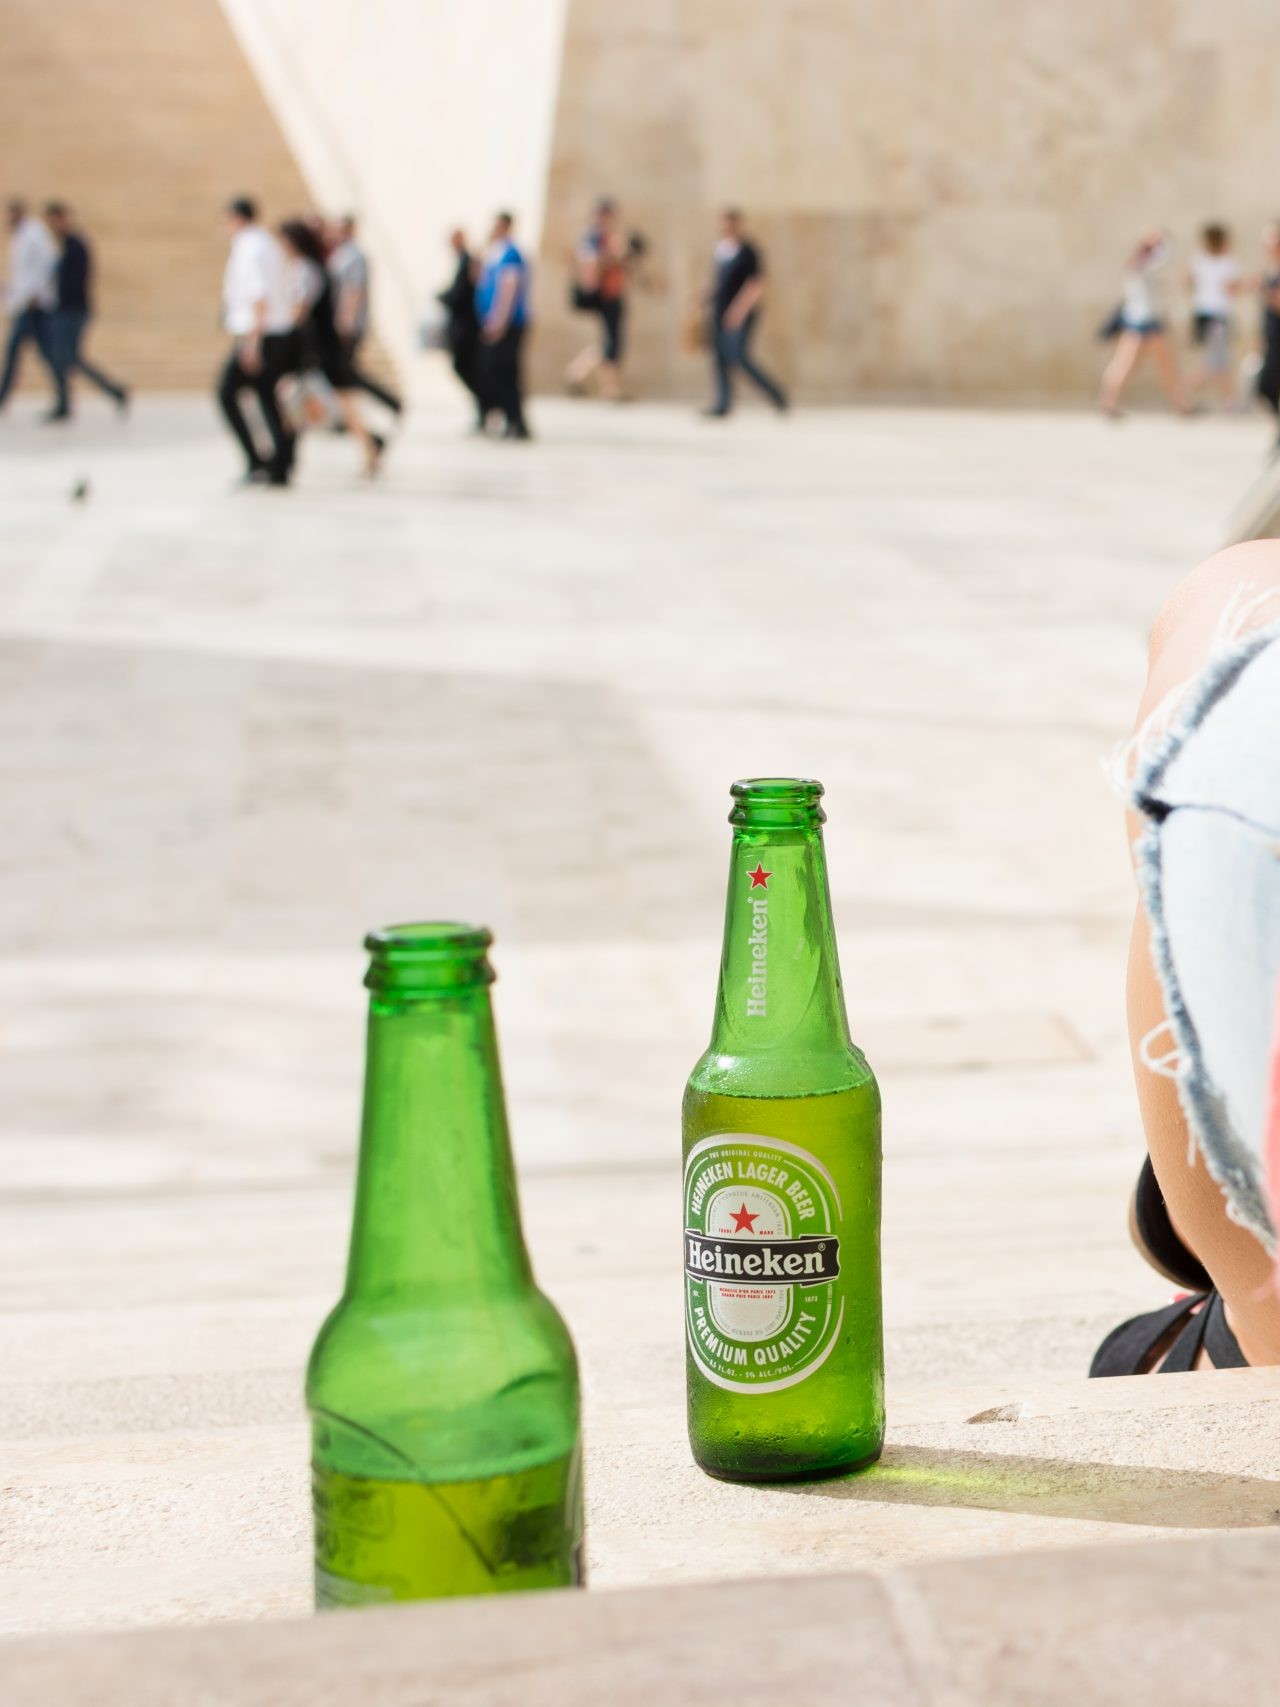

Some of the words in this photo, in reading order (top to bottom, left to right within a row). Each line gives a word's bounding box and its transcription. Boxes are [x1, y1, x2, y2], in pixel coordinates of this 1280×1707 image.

[746, 898, 769, 1018] Heineken
[720, 1149, 750, 1158] ORIGINAL
[691, 1161, 734, 1216] HEINEKEN
[737, 1161, 789, 1190] LAGER
[786, 1180, 816, 1220] BEER
[688, 1239, 825, 1277] Heineken
[694, 1306, 748, 1366] PREMIUM
[753, 1310, 817, 1366] QUALITY
